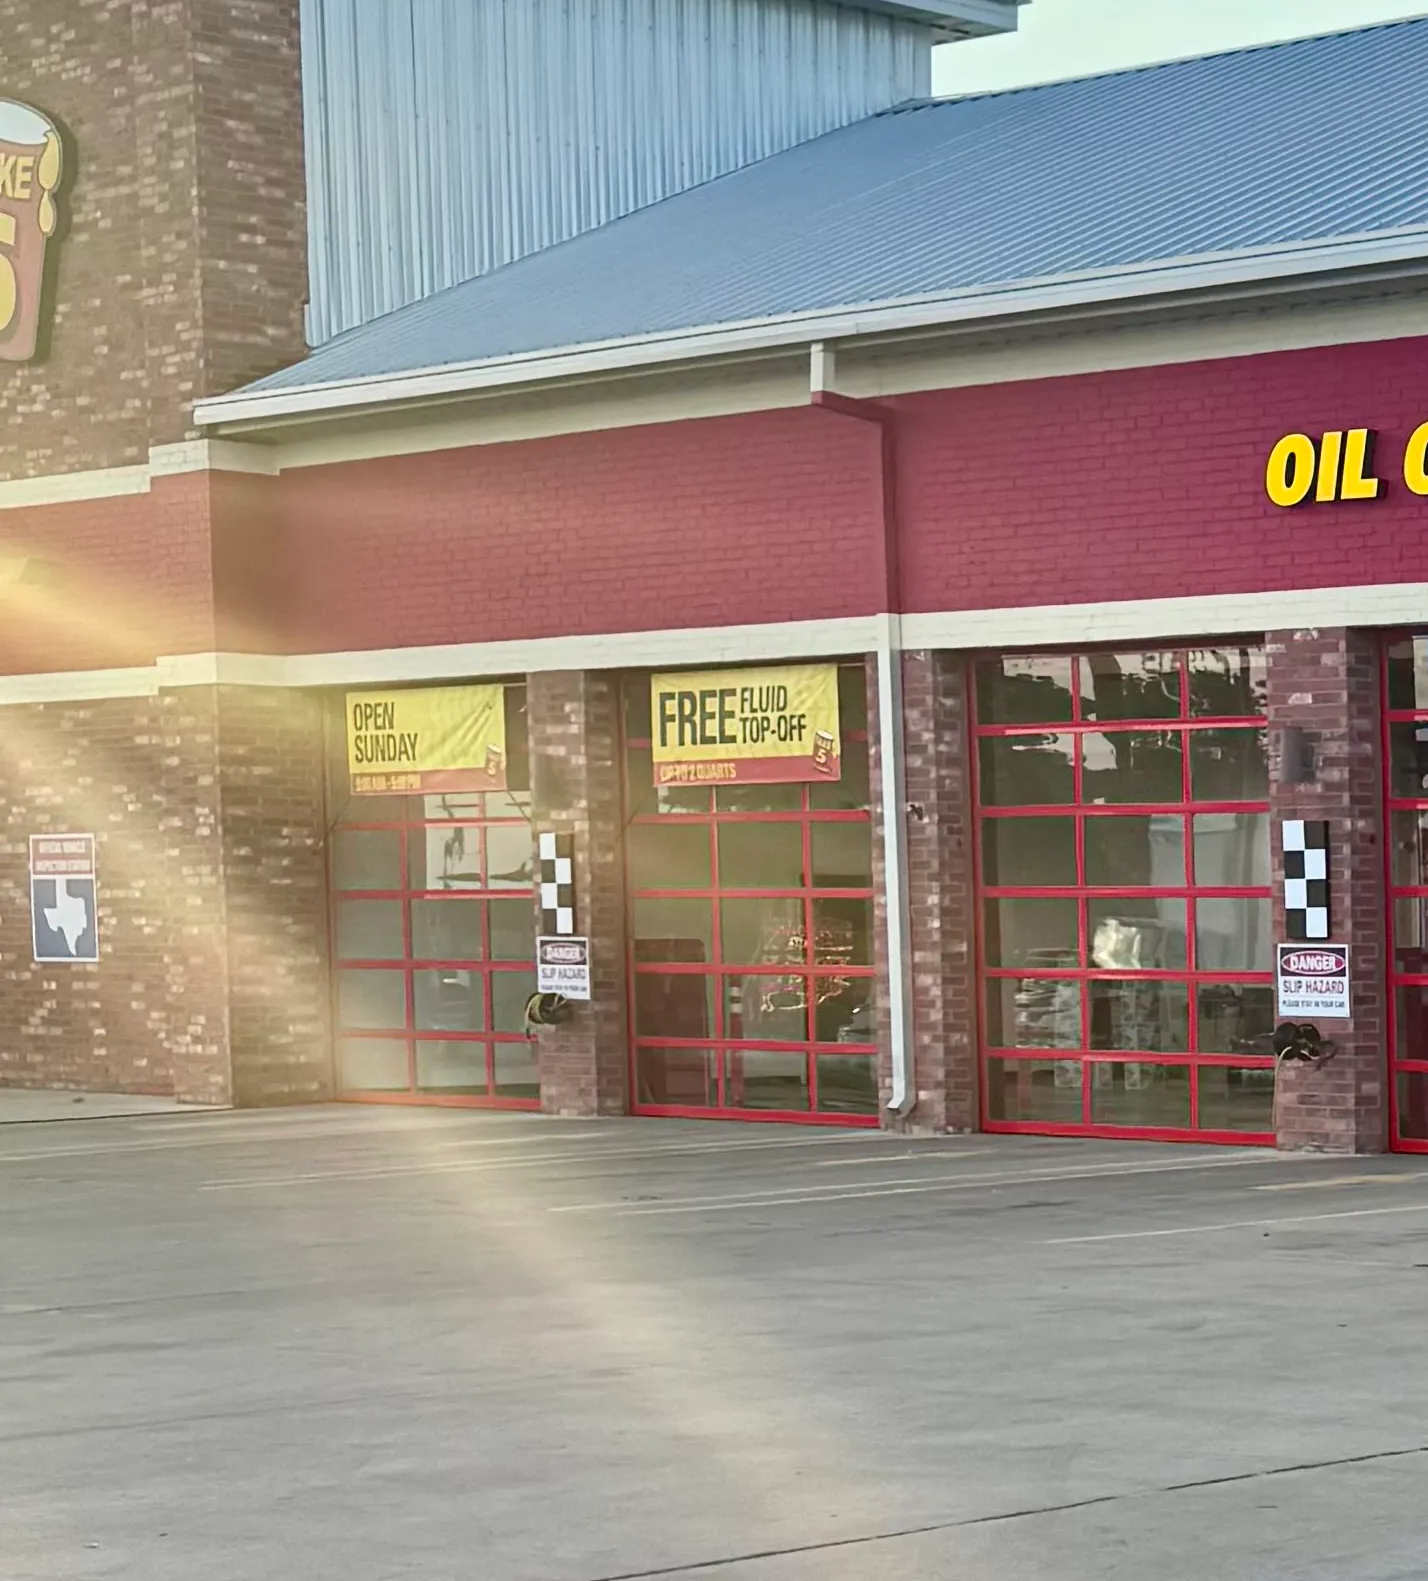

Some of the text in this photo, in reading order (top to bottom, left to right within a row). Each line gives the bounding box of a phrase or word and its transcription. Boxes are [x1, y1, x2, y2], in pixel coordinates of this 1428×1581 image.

[0, 153, 35, 199] KE
[1265, 428, 1379, 507] OIL
[353, 701, 395, 732] OPEN
[659, 685, 788, 747] FREE FLUID
[739, 713, 807, 743] TOP-OFF
[354, 732, 418, 764] SUNDAY
[697, 762, 737, 781] QUARTS
[1289, 955, 1336, 971] DANGER
[1283, 979, 1345, 994] SLIP HAZARD
